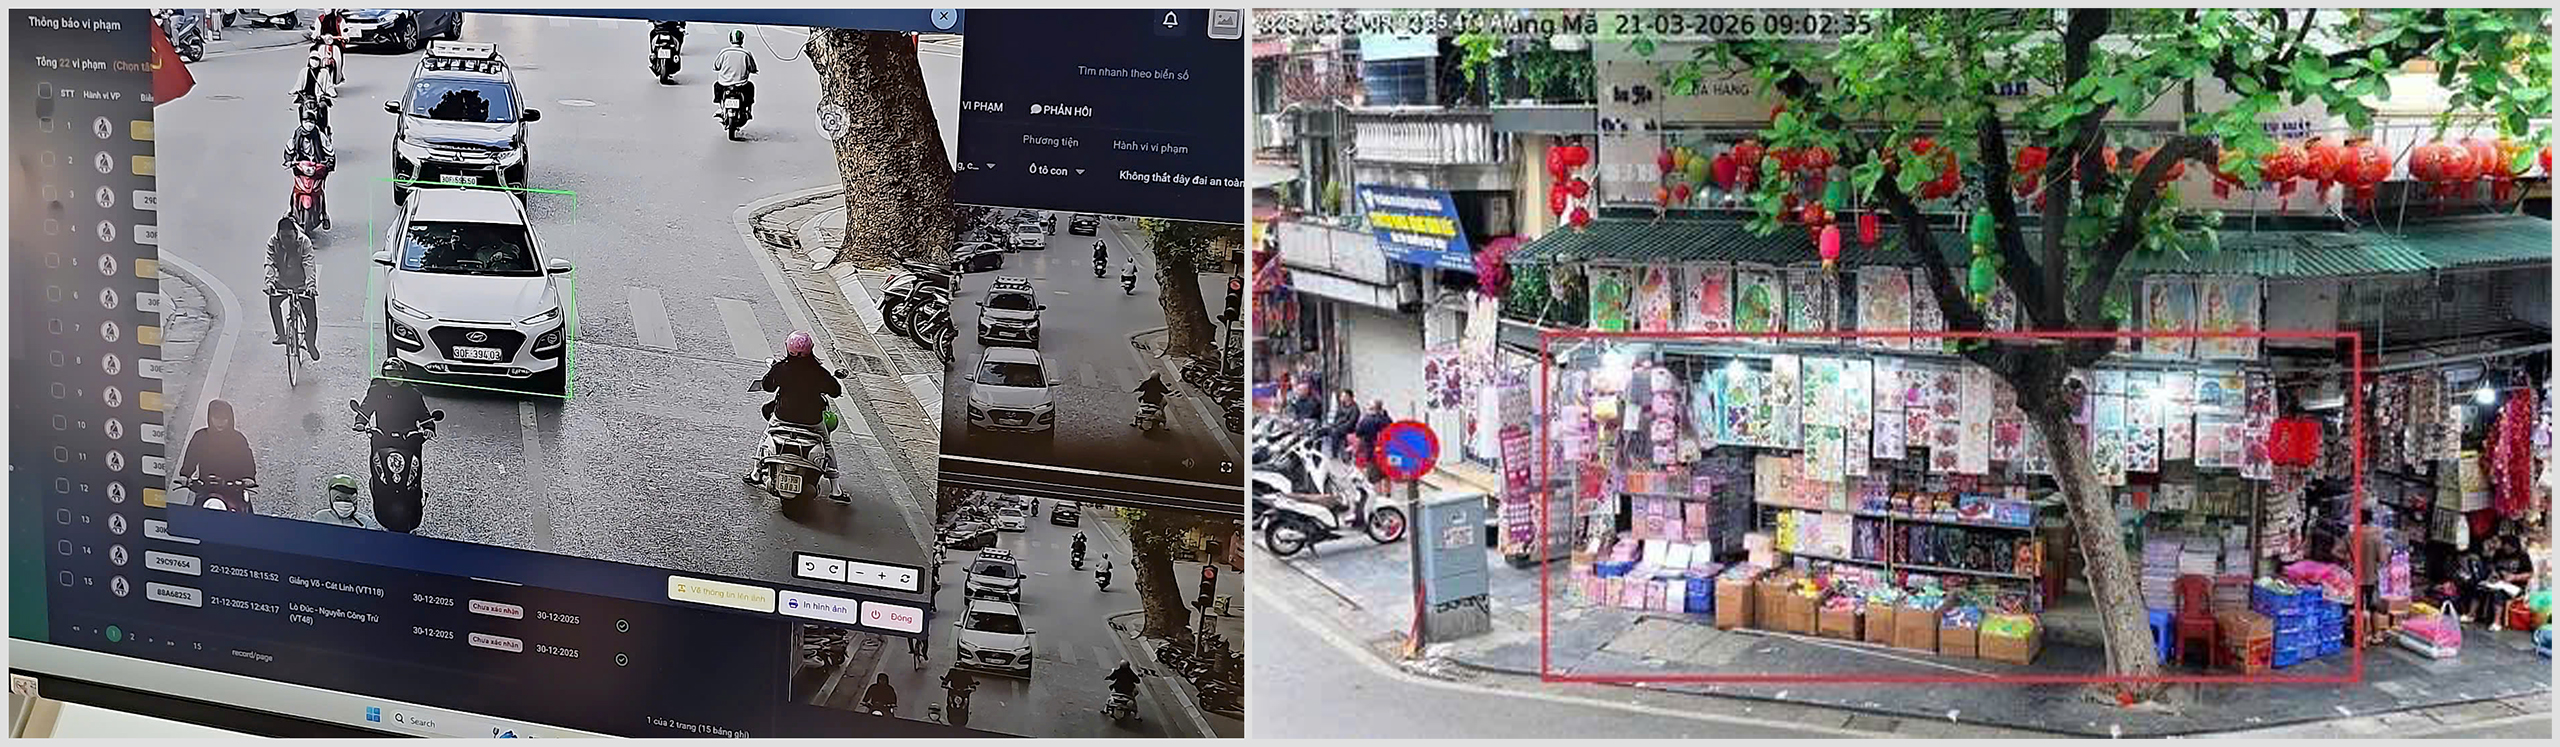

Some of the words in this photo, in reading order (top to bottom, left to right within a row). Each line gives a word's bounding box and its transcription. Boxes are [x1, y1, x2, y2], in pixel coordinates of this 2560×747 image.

[28, 16, 59, 30] Thông
[61, 17, 80, 28] báo
[82, 18, 91, 29] vi
[93, 18, 121, 33] phạm
[60, 58, 70, 68] 22
[72, 59, 80, 68] vi
[81, 59, 107, 71] phạm
[113, 60, 139, 72] (Chọn
[1078, 66, 1097, 76] Tìm
[1098, 68, 1129, 78] nhanh
[1130, 69, 1152, 79] theo
[1177, 69, 1190, 81] số
[61, 89, 75, 98] STT
[83, 90, 102, 99] Hành
[102, 91, 109, 99] vi
[110, 91, 121, 100] VP
[962, 101, 972, 110] VI
[973, 101, 1004, 113] PHẠM
[1043, 103, 1073, 116] PHẢN
[1022, 134, 1060, 148] Phương
[1061, 137, 1079, 148] tiện
[1113, 140, 1139, 151] Hành
[1140, 142, 1149, 151] vi
[1150, 143, 1159, 152] vi
[1160, 143, 1189, 155] phạm
[68, 156, 73, 165] 2
[1029, 162, 1037, 174] Ô
[1038, 165, 1049, 174] tô
[1050, 167, 1068, 176] con
[1119, 170, 1150, 183] Không
[1152, 172, 1171, 183] thắt
[1172, 173, 1191, 187] dây
[1191, 175, 1208, 186] đai
[1209, 179, 1222, 187] an
[1224, 178, 1245, 188] toàn
[69, 189, 75, 199] 3
[70, 224, 76, 233] 4
[73, 291, 79, 300] 6
[75, 323, 80, 332] 7
[76, 356, 82, 365] 8
[77, 388, 83, 397] 9
[77, 420, 86, 429] 10
[78, 452, 87, 460] 11
[80, 484, 89, 492] 12
[81, 515, 91, 524] 13
[82, 546, 92, 555] 14
[155, 556, 191, 569] 29C97654
[209, 564, 249, 577] 22-12-2025
[249, 570, 280, 582] 18:15:52
[83, 577, 93, 586] 15
[157, 588, 192, 601] 88A68252
[325, 581, 338, 591] Cát
[339, 583, 354, 593] Linh
[355, 585, 385, 599] (VT118)
[210, 596, 249, 609] 21-12-2025
[250, 603, 280, 614] 12:43:17
[412, 593, 455, 607] 30-12-2025
[299, 603, 314, 614] Đúc
[319, 607, 346, 619] Nguyễn
[346, 611, 366, 623] Công
[472, 602, 490, 612] Chưa
[490, 604, 502, 613] xác
[803, 601, 811, 609] In
[831, 604, 847, 614] ảnh
[289, 614, 314, 626] (VT48)
[536, 611, 580, 625] 30-12-2025
[890, 612, 913, 624] Đóng
[130, 633, 135, 641] 2
[412, 626, 455, 640] 30-12-2025
[193, 642, 202, 650] 15
[472, 635, 490, 645] Chưa
[490, 638, 502, 646] xác
[231, 648, 274, 662] record/page
[536, 644, 579, 658] 30-12-2025
[410, 716, 436, 728] Search
[646, 716, 651, 724] 1
[653, 717, 668, 727] của
[669, 719, 675, 728] 2
[676, 721, 697, 733] trang
[698, 723, 712, 733] (15
